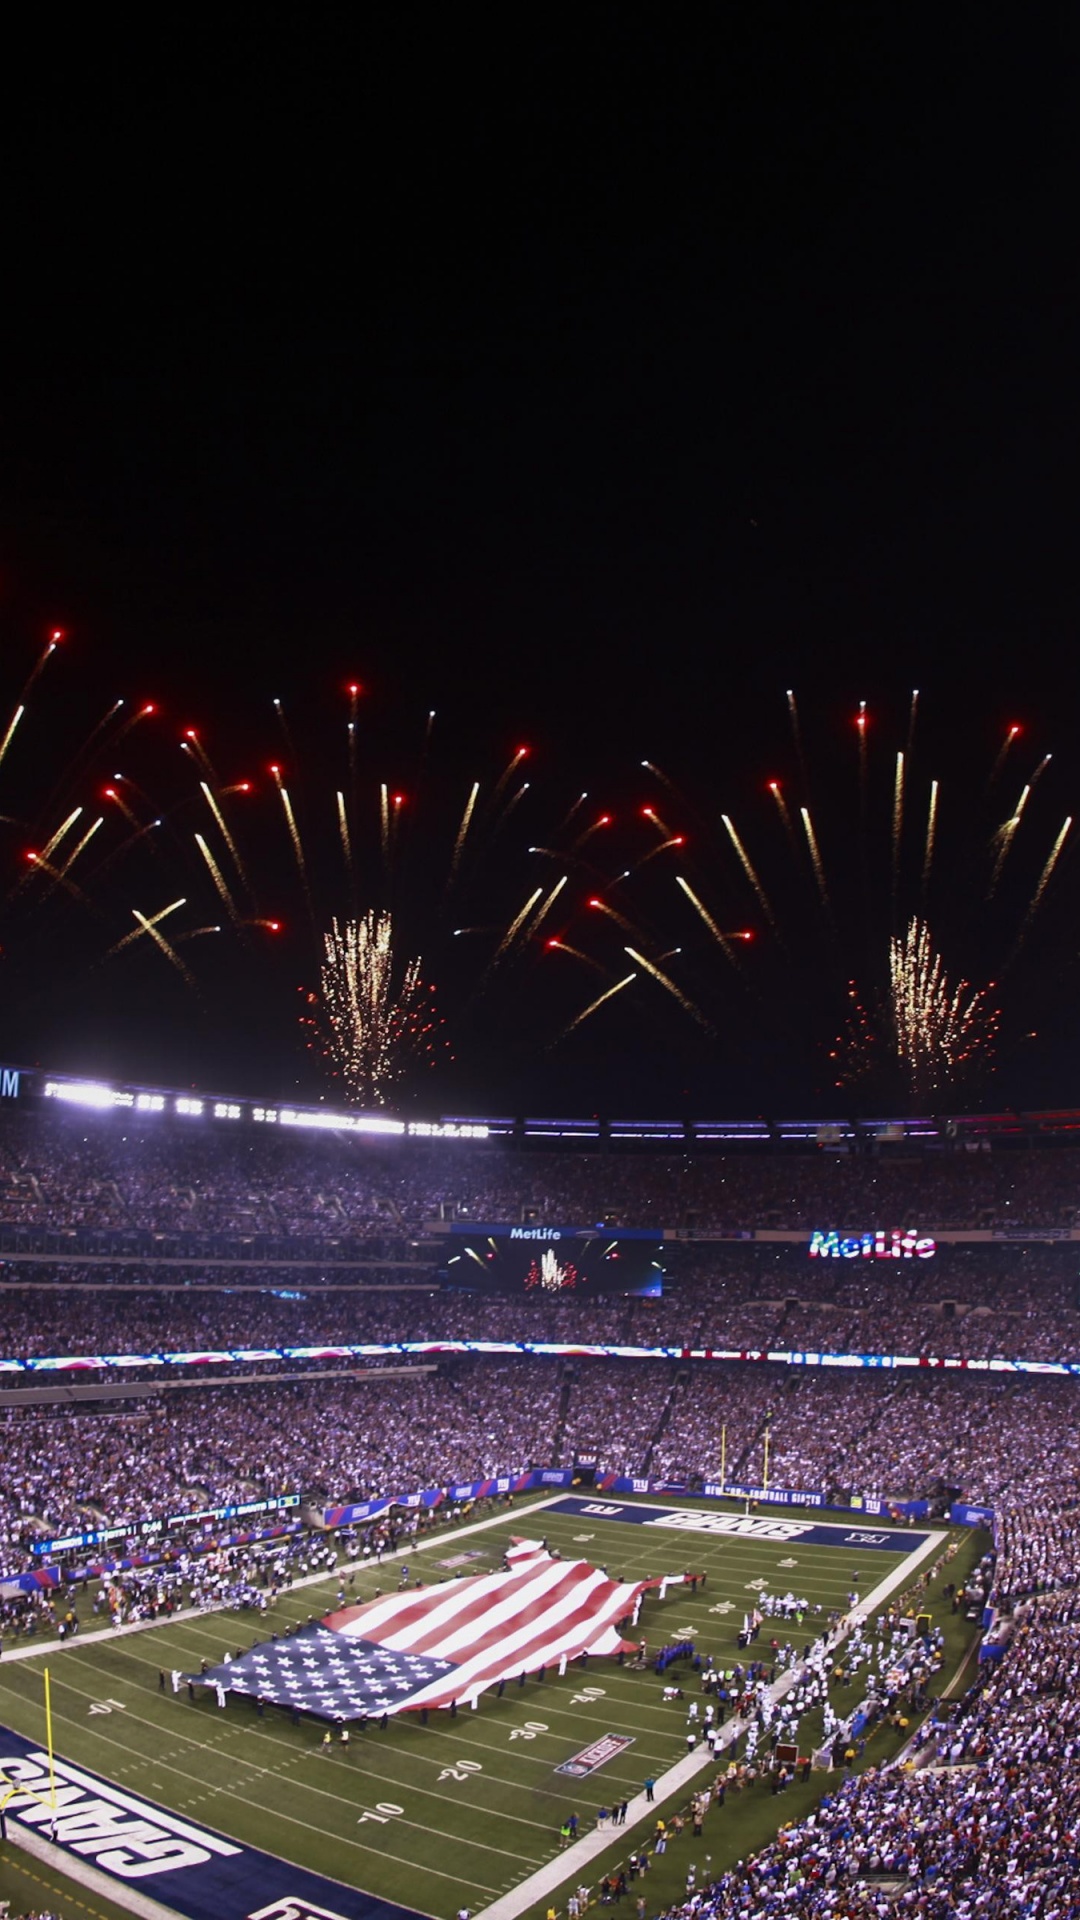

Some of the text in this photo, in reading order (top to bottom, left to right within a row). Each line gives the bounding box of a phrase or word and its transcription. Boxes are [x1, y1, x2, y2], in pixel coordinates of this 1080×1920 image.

[510, 1227, 562, 1241] MetLife
[808, 1229, 938, 1258] MetLife
[632, 1479, 649, 1492] ny
[705, 1485, 724, 1496] NEW
[866, 1499, 880, 1515] ny
[639, 1512, 815, 1541] GIANTS
[744, 1578, 769, 1591] 20
[708, 1601, 736, 1615] 30
[575, 1687, 606, 1703] 40
[90, 1699, 127, 1715] 10
[515, 1721, 549, 1739] 30
[441, 1760, 483, 1781] 20
[0, 1757, 212, 1878] GIANTS
[361, 1802, 405, 1824] 10
